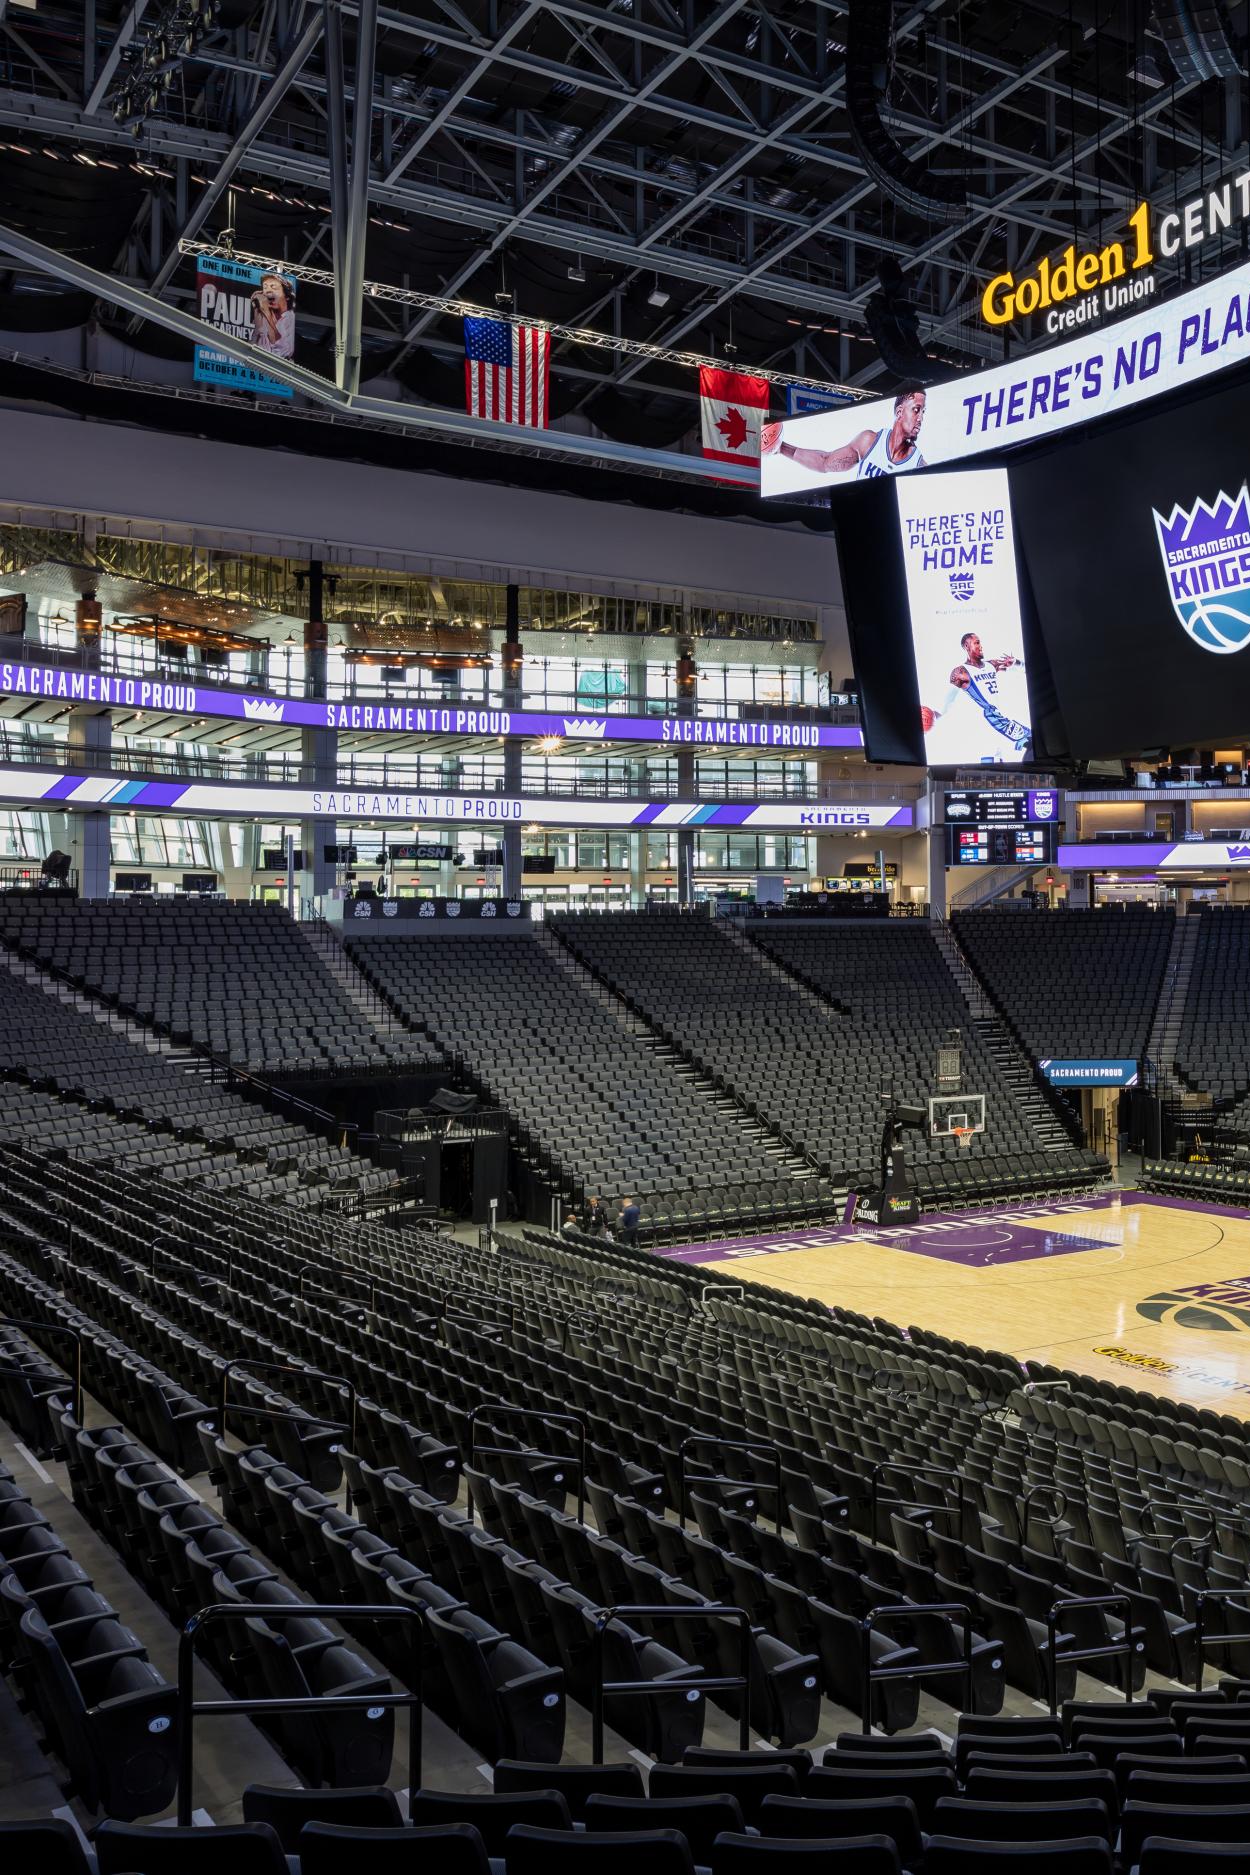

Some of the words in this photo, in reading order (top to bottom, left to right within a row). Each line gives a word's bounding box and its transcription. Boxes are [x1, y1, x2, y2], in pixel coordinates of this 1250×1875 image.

[202, 259, 219, 272] ONE
[221, 262, 233, 275] ON
[236, 265, 253, 279] ONE
[982, 245, 1125, 325] Golden
[1129, 201, 1154, 269] 1
[200, 283, 256, 329] PAUL
[1046, 291, 1099, 334] Credit
[1104, 276, 1155, 312] Union
[199, 361, 238, 377] OCTOBER
[240, 368, 246, 378] 4
[963, 356, 1104, 435] THERE'S
[1113, 331, 1163, 390] NO
[906, 512, 975, 534] THERE'S
[981, 509, 1004, 525] NO
[910, 529, 962, 549] PLACE
[968, 525, 1005, 543] LIKE
[1168, 531, 1250, 564] SACRAMENTO
[923, 543, 994, 570] HOME
[950, 582, 974, 590] SAC
[2, 664, 135, 705] SACRAMENTO
[141, 681, 196, 712] PROUD
[327, 704, 449, 734] SACRAMENTO
[456, 709, 510, 735] PROUD
[662, 719, 768, 744] SACRAMENTO
[773, 723, 820, 747] PROUD
[313, 793, 454, 818] SACRAMENTO
[463, 797, 522, 819] PROUD
[801, 813, 870, 824] KINGS
[416, 847, 447, 858] CSN
[1051, 1069, 1098, 1077] SACRAMENTO
[1100, 1069, 1122, 1077] PROUD
[725, 1205, 1093, 1258] SACRAMENTO
